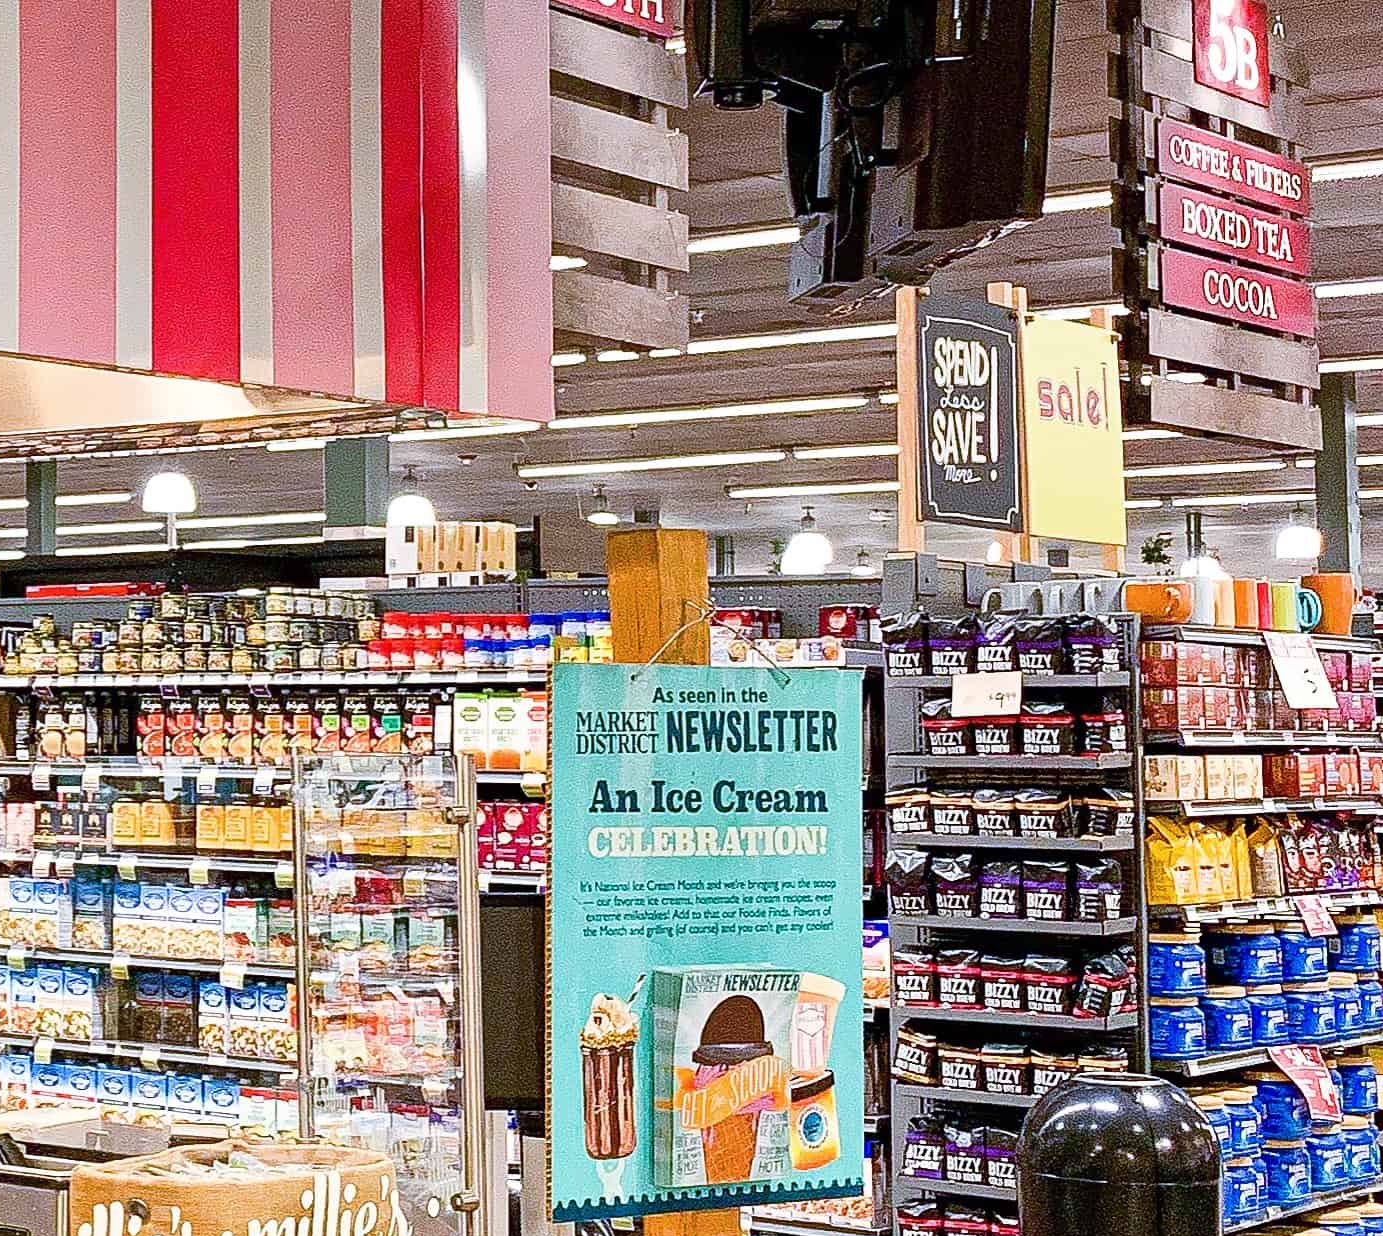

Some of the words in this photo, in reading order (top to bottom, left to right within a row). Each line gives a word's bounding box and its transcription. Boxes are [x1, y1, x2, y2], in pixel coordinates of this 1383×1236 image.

[1208, 0, 1260, 90] 5B
[1169, 135, 1229, 179] COFFEE
[1232, 155, 1243, 183] &
[1245, 157, 1302, 201] FILTERS
[1182, 199, 1251, 249] BOXED
[1253, 223, 1294, 263] TEA
[1203, 269, 1278, 320] COCOA
[933, 336, 990, 387] SPEND
[932, 410, 987, 465] SAVE
[1019, 654, 1052, 669] BIZZY
[652, 687, 674, 704] As
[678, 690, 716, 704] seen
[721, 687, 737, 703] in
[741, 687, 768, 703] the
[576, 711, 659, 733] MARKET
[666, 710, 838, 754] NEWSLETTER
[929, 732, 963, 746] BIZZY
[975, 729, 1009, 744] BIZZY
[1024, 729, 1059, 745] BIZZY
[576, 733, 659, 755] DISTRICT
[588, 780, 641, 814] An
[651, 780, 705, 814] Ice
[713, 779, 829, 814] Cream
[934, 809, 968, 825] BIZZY
[977, 814, 1010, 829] BIZZY
[1020, 815, 1055, 830] BIZZY
[587, 825, 829, 858] CELEBRATION!
[892, 895, 925, 910] BIZZY
[936, 894, 969, 909] BIZZY
[981, 888, 1015, 904] BIZZY
[1027, 893, 1062, 909] BIZZY
[672, 910, 689, 919] Add
[723, 973, 801, 992] NEWSLETTER
[940, 978, 976, 994] BIZZY
[984, 982, 1020, 999] BIZZY
[1027, 986, 1062, 1003] BIZZY
[942, 1062, 976, 1079] BIZZY
[986, 1067, 1021, 1085] BIZZY
[947, 1156, 981, 1173] BIZZY
[988, 1161, 1016, 1178] BIZZ
